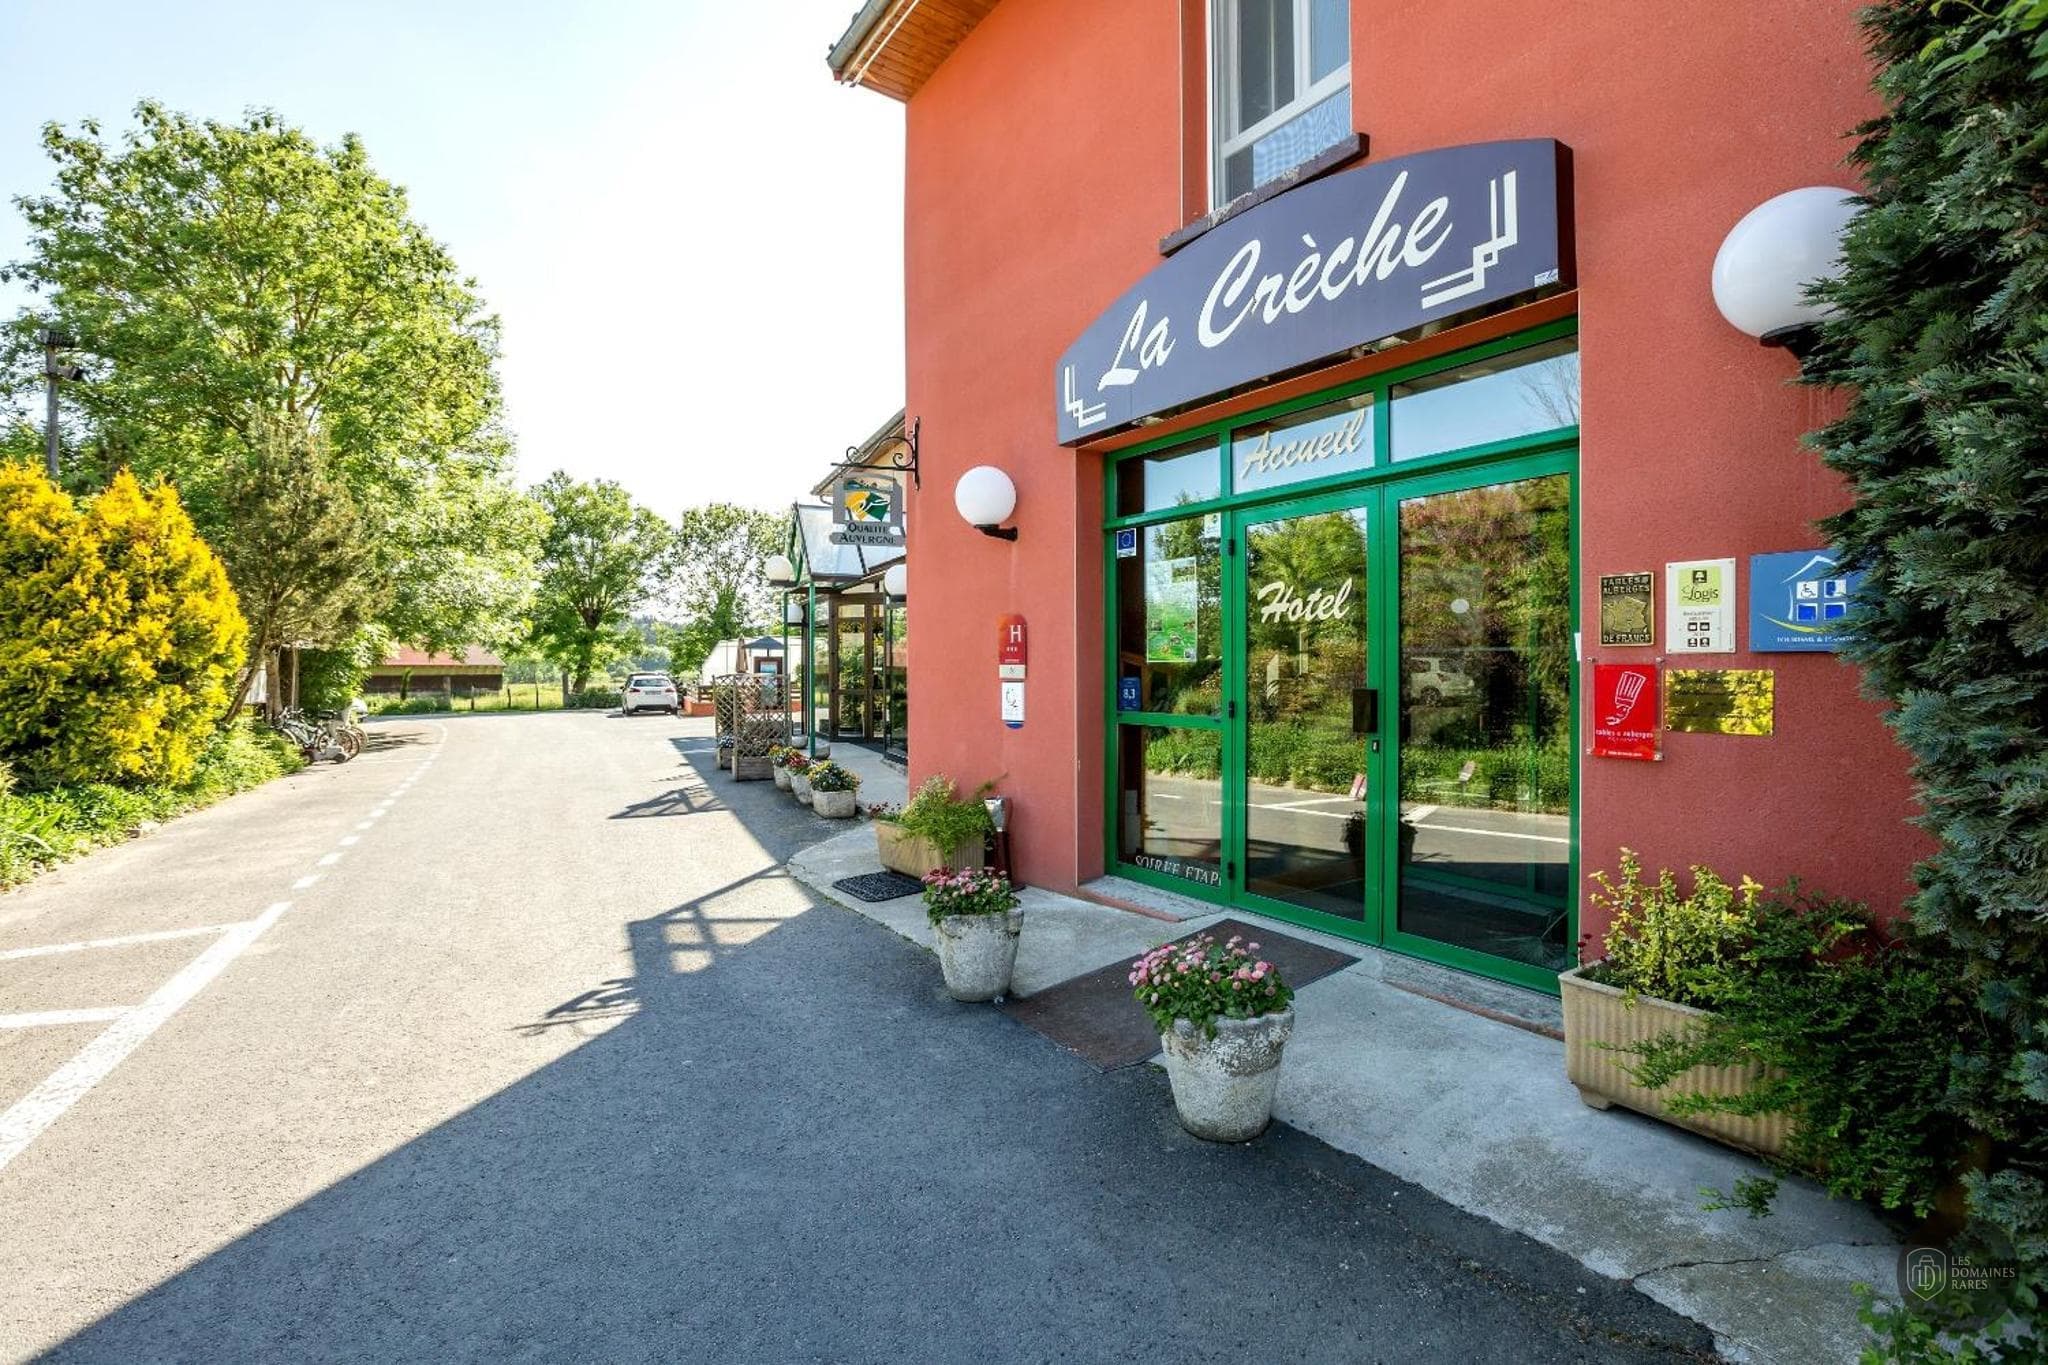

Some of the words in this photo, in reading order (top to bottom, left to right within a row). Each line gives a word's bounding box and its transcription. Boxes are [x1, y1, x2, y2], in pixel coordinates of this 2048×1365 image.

[1098, 300, 1176, 391] La
[1198, 171, 1453, 349] Crèche
[1241, 408, 1365, 479] Accueil
[1257, 577, 1353, 623] Hotel
[1010, 624, 1021, 643] H
[1185, 866, 1222, 887] ETAP
